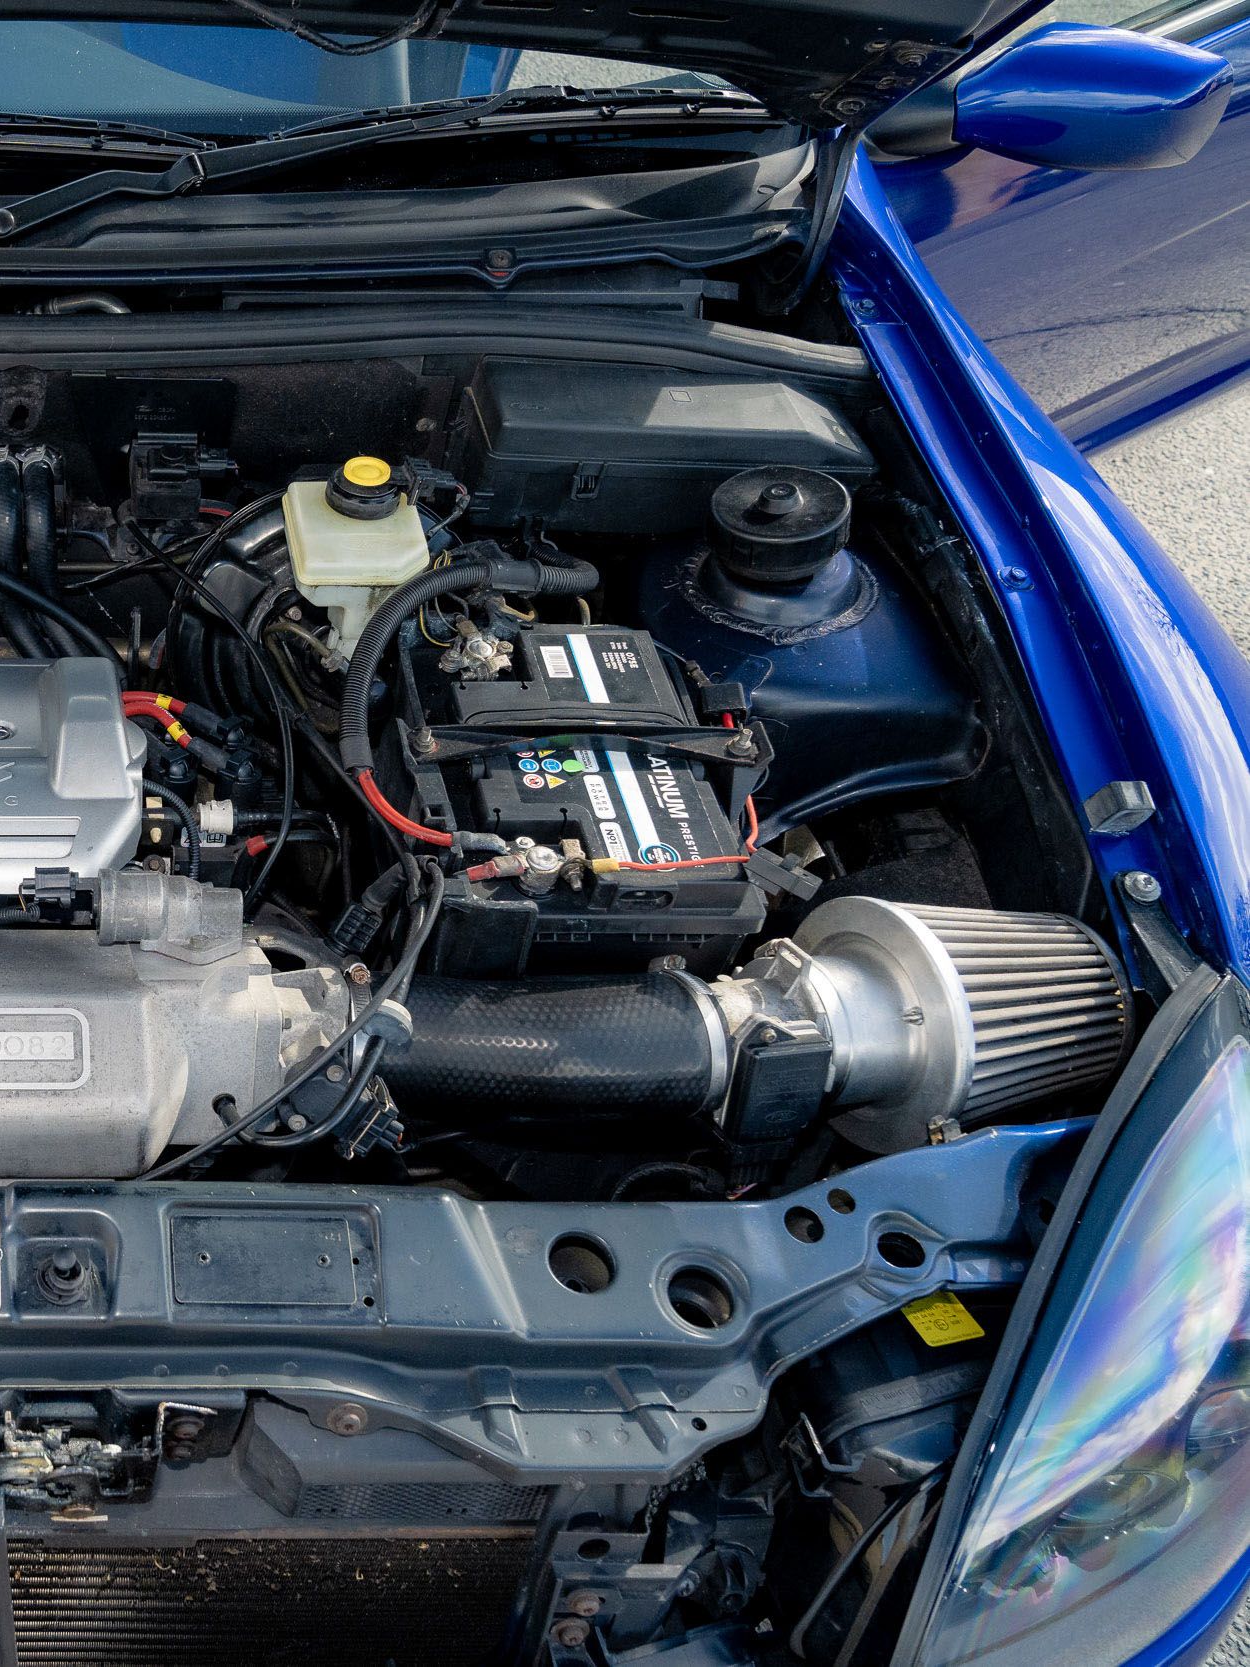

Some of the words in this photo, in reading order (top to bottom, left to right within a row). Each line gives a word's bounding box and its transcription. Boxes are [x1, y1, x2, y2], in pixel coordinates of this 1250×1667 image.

[589, 783, 602, 812] POWER
[595, 783, 610, 812] EXTRA
[647, 753, 690, 819] ATINUM
[678, 822, 705, 868] PRESTIG
